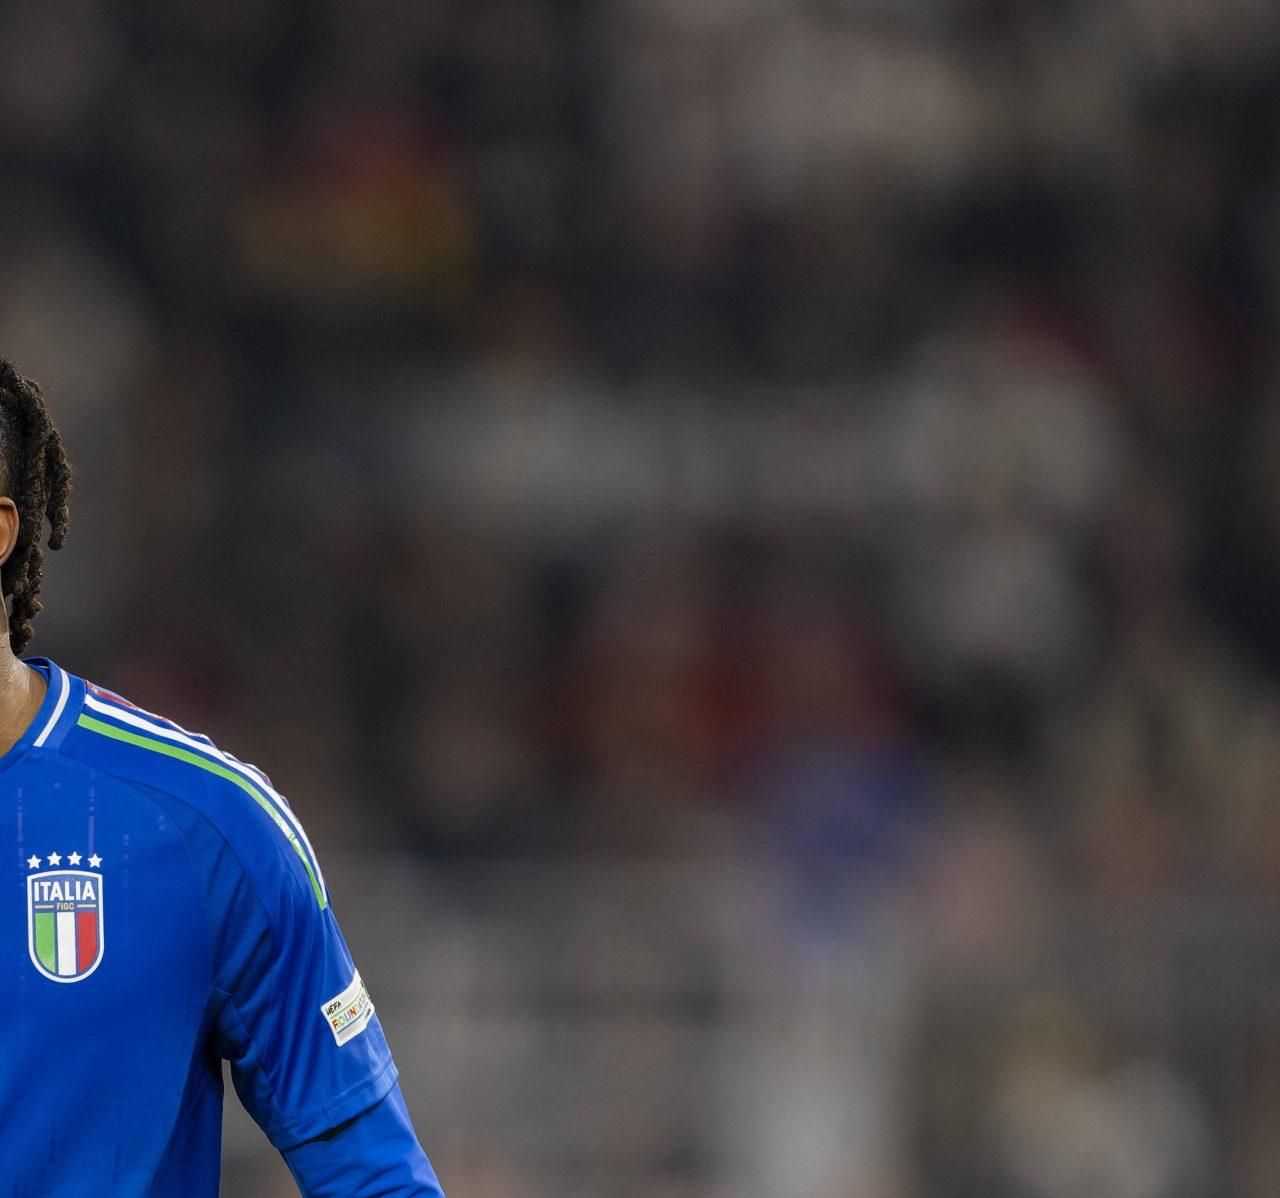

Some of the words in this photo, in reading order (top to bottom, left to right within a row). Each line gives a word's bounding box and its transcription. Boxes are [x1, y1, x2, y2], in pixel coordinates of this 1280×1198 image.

[34, 880, 97, 902] ITALIA
[56, 902, 75, 910] FIGC
[325, 1000, 342, 1016] UEFA
